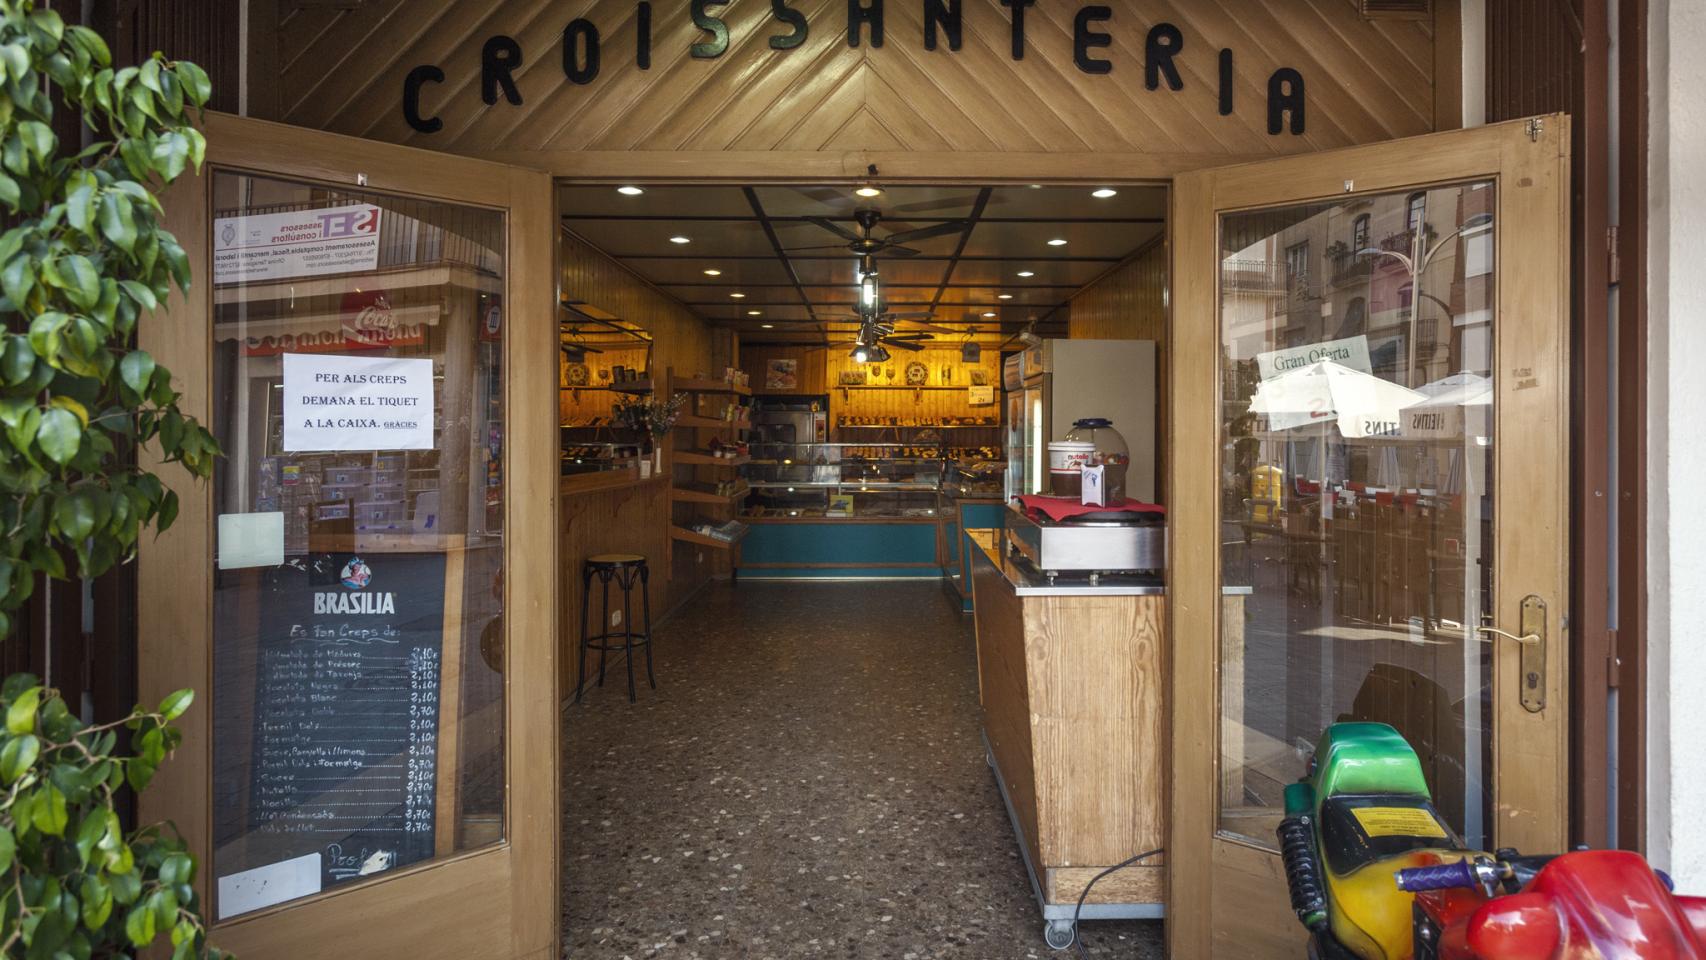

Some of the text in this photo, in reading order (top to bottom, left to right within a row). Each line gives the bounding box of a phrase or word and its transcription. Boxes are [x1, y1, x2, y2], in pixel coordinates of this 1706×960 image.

[402, 0, 1306, 136] CROISSANTERIA
[1274, 347, 1351, 371] Gran Oferta
[315, 373, 408, 385] PER ALS CREPS
[302, 395, 419, 407] DEMANA EL TIQUET
[303, 419, 314, 428] A
[317, 419, 335, 428] LA
[337, 418, 381, 429] CAIXA.
[1067, 452, 1089, 461] nutella
[313, 591, 396, 615] BRASILIA
[289, 624, 308, 637] Es
[339, 623, 379, 640] Creps
